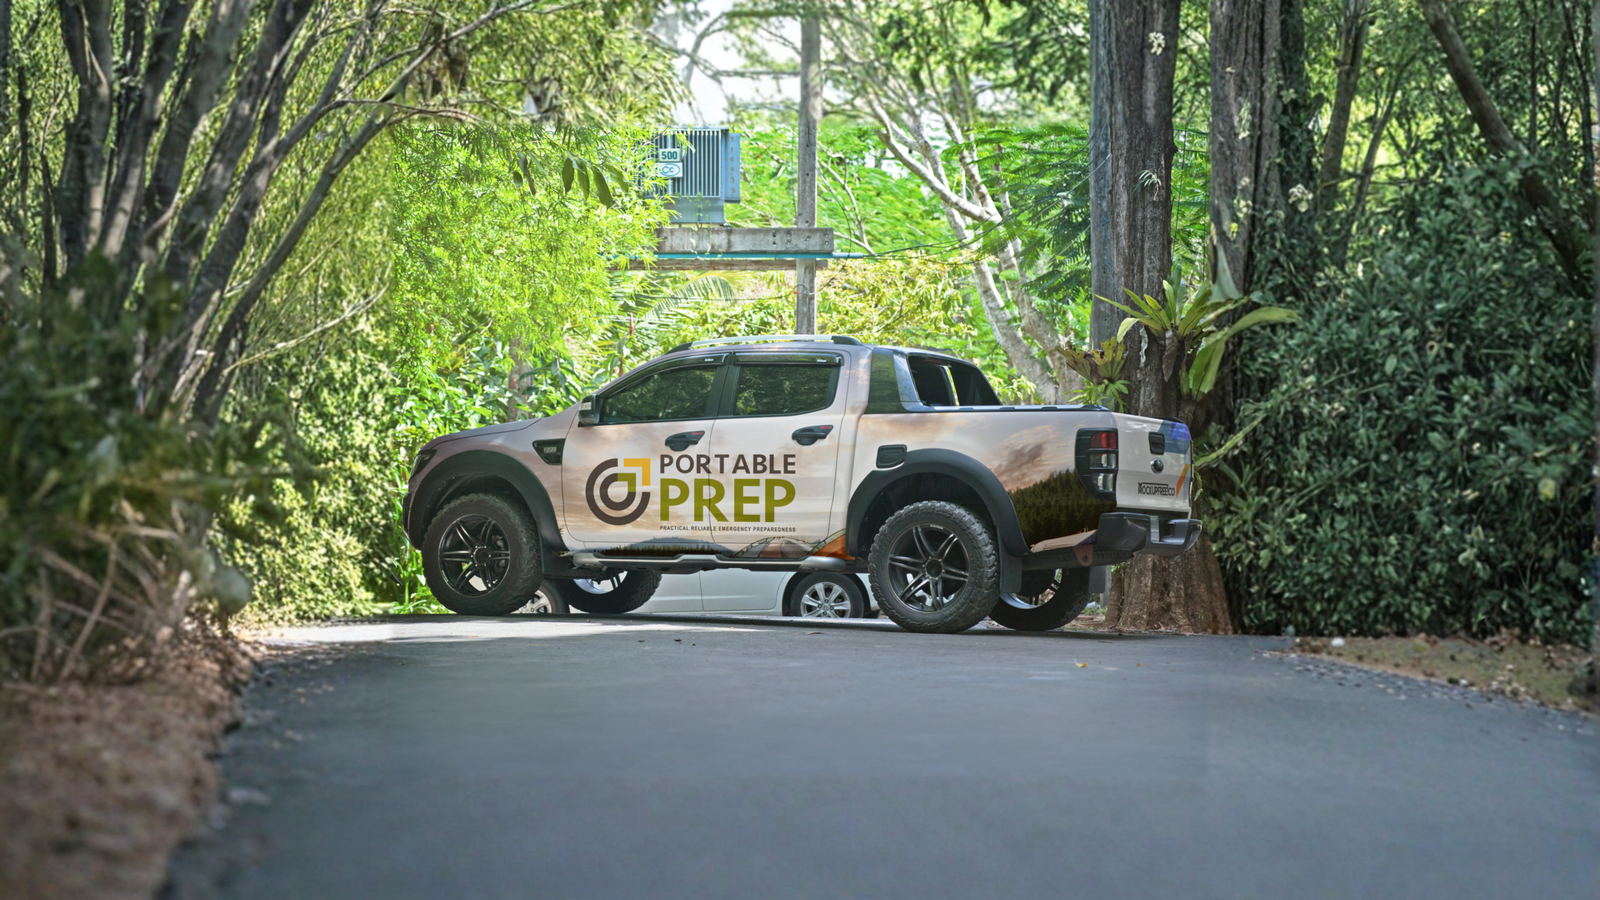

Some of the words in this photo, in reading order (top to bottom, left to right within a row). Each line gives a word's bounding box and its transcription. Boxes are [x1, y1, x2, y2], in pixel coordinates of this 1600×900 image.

[661, 151, 678, 160] 500
[660, 454, 796, 474] PORTABLE
[660, 478, 796, 522] PREP
